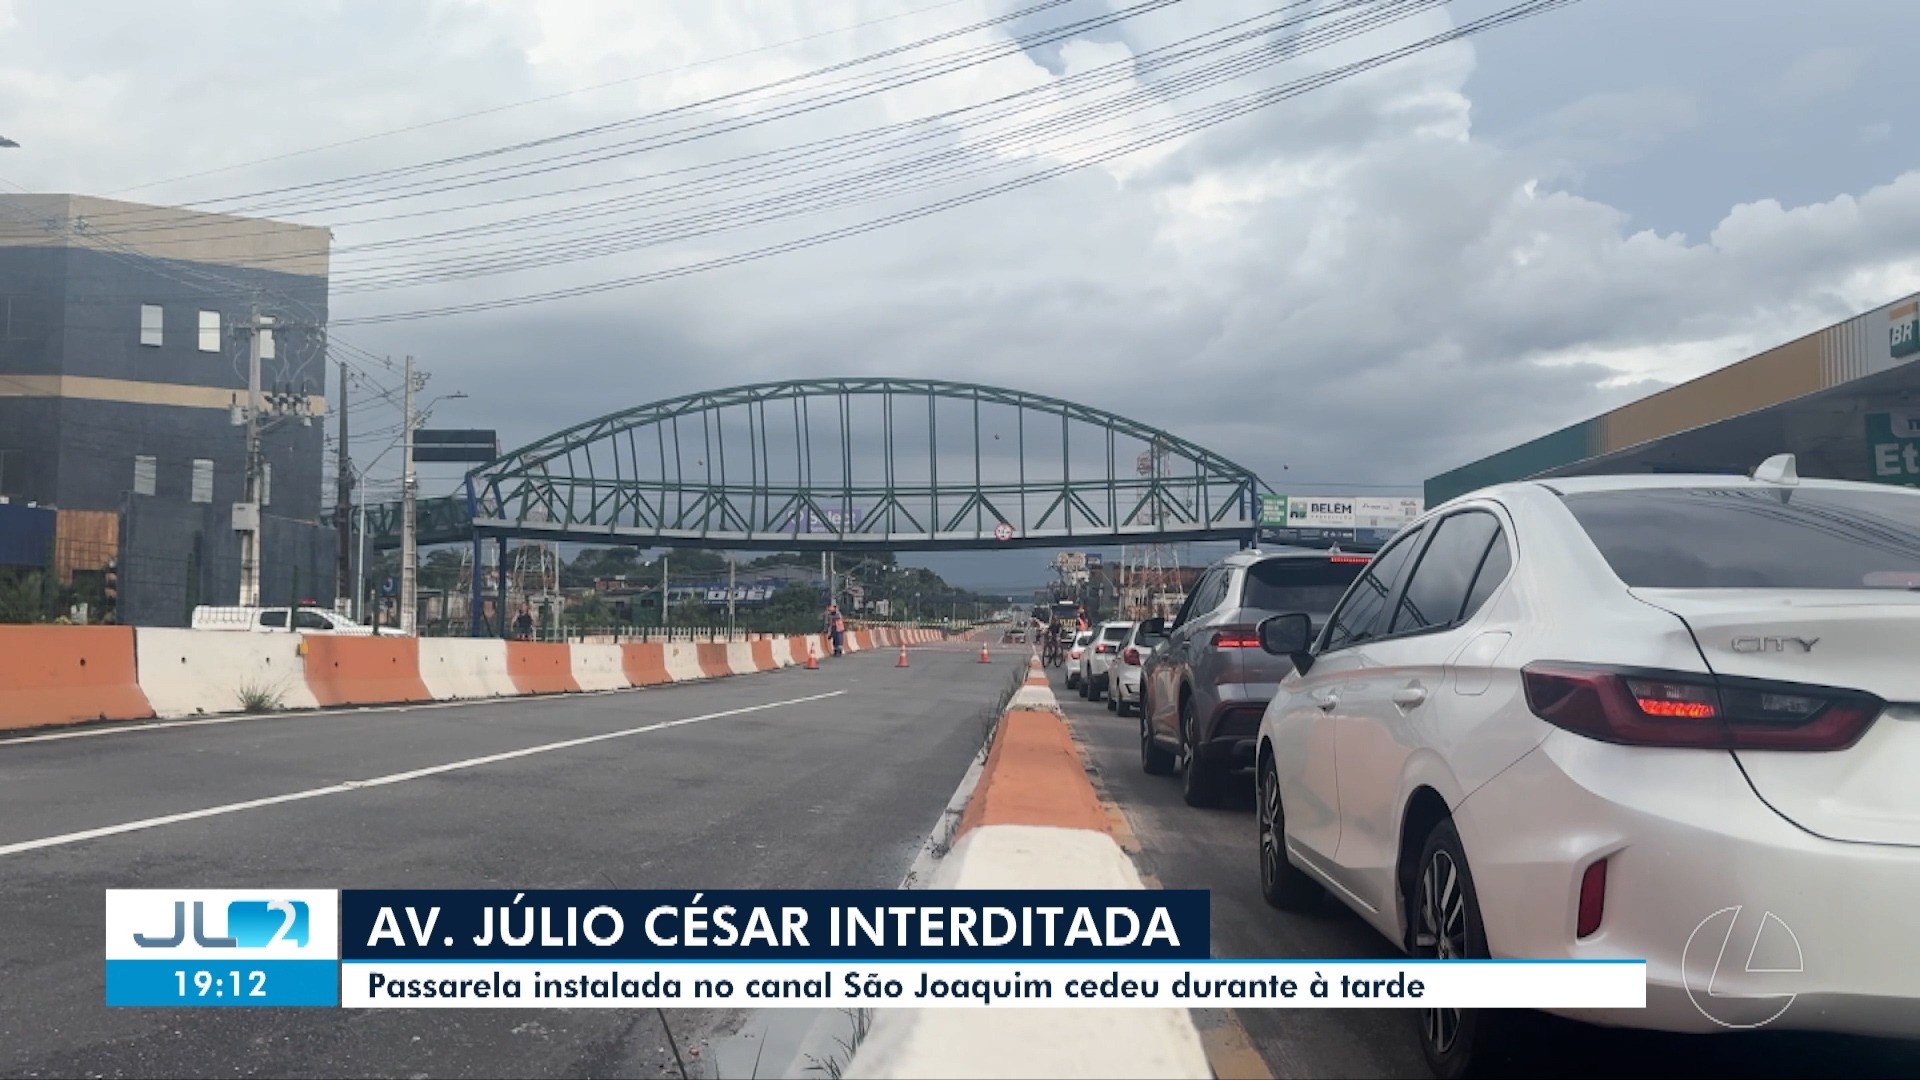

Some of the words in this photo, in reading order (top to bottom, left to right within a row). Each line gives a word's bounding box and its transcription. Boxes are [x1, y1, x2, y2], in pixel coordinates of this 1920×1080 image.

[1891, 323, 1913, 346] BR
[810, 510, 856, 525] Slect
[1731, 636, 1820, 653] CITY
